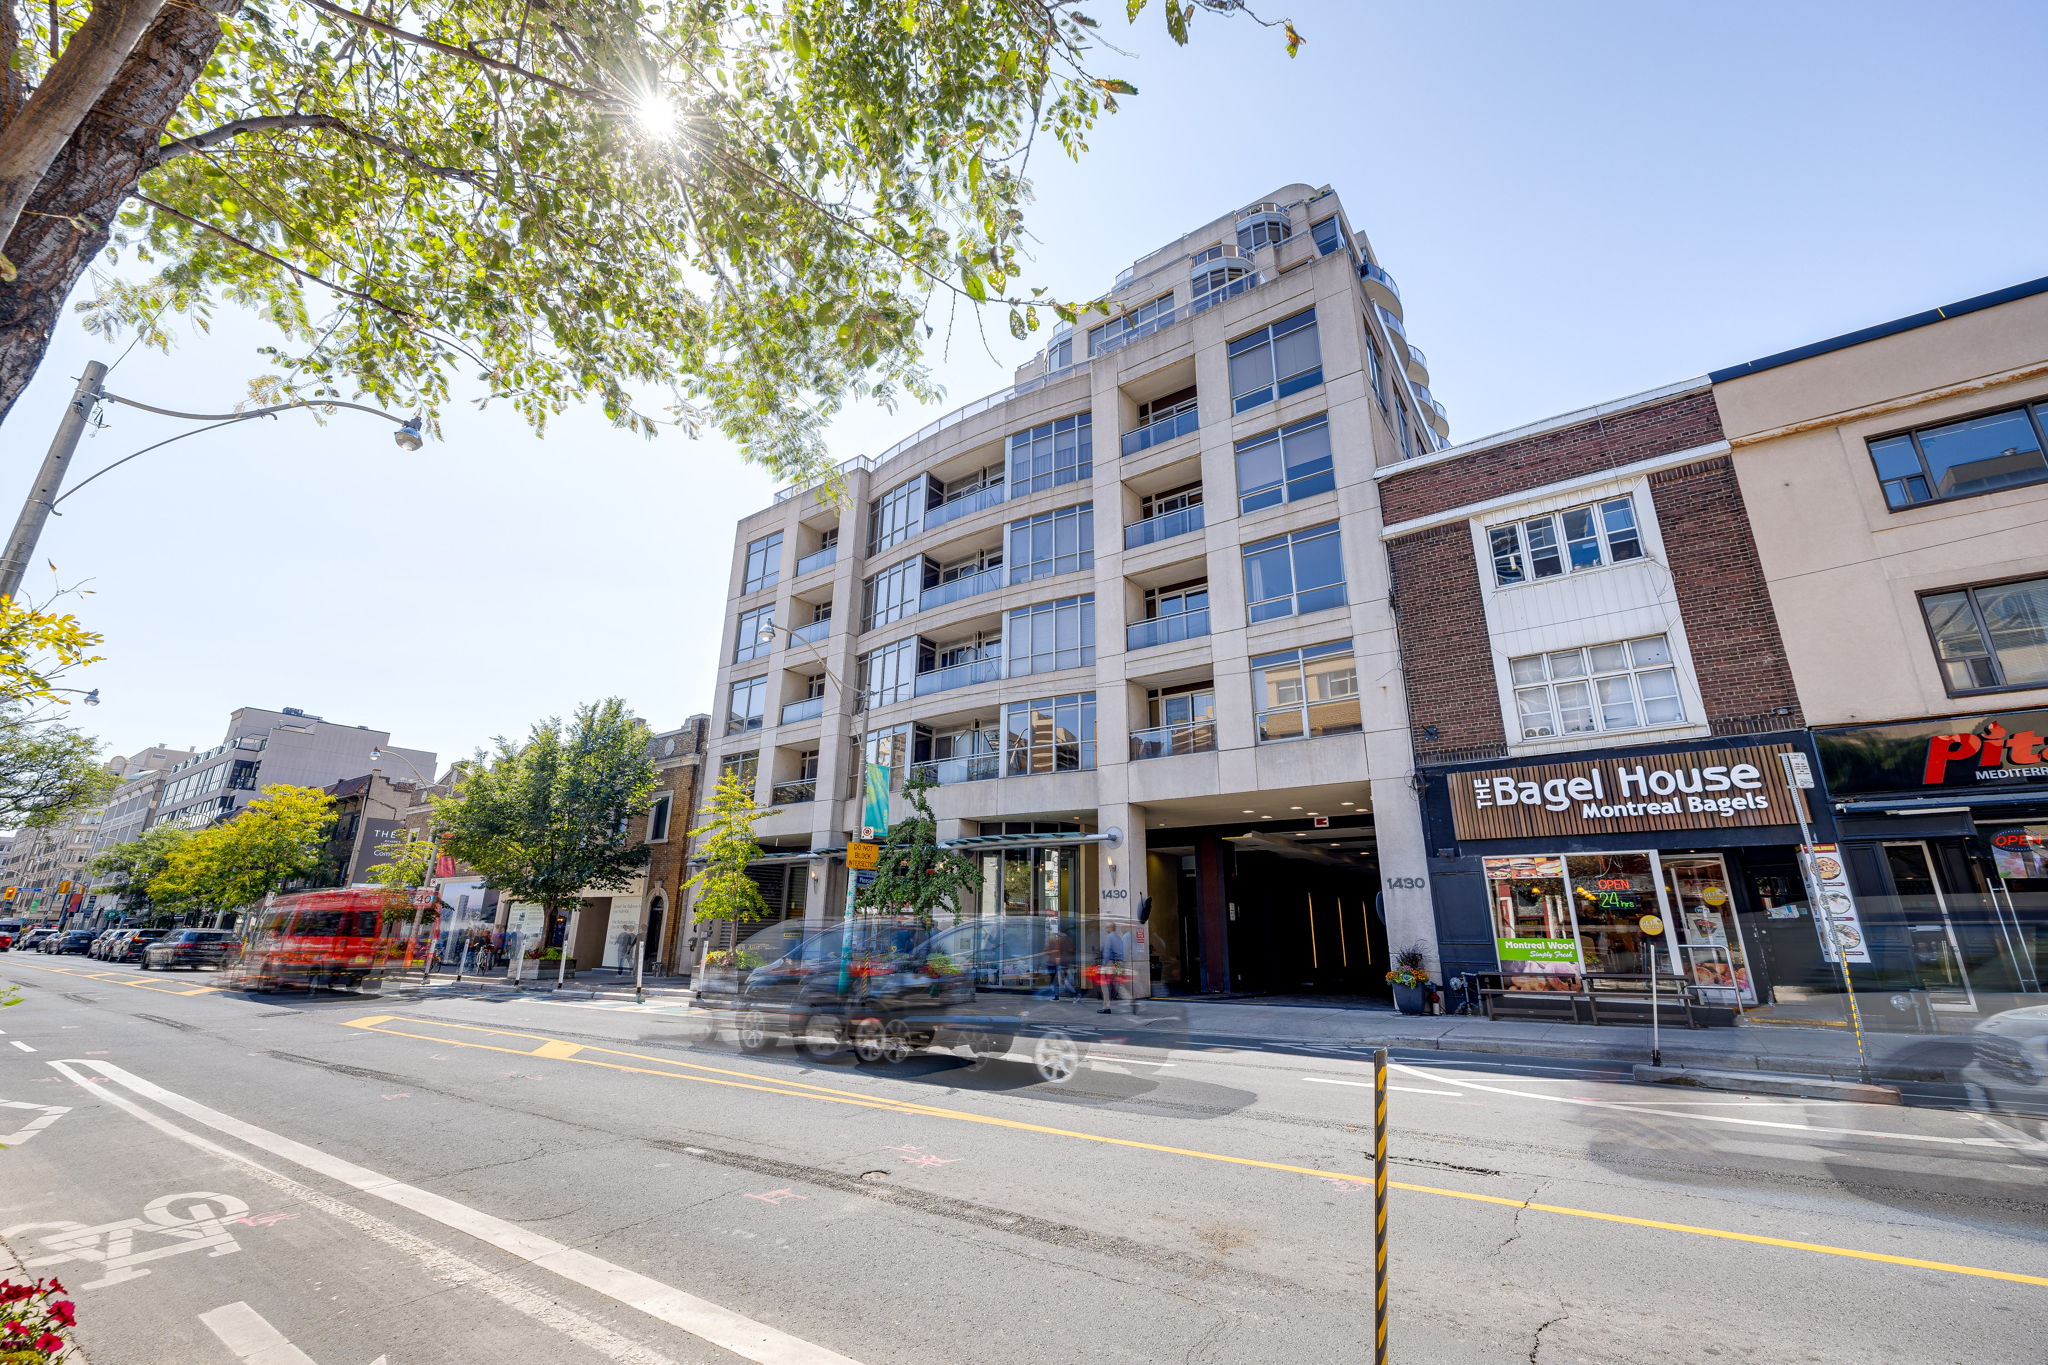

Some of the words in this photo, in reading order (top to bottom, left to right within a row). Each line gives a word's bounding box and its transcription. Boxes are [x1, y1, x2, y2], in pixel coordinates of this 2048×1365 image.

[1473, 778, 1491, 810] THE
[1492, 767, 1604, 812] Bagel
[1618, 763, 1763, 799] House
[1582, 797, 1684, 819] Montreal
[1689, 792, 1769, 817] Bagels
[1994, 834, 2043, 847] OPEN
[1386, 877, 1426, 890] 1430
[1598, 879, 1631, 890] OPEN
[1102, 889, 1128, 899] 1430
[1600, 891, 1620, 908] 24
[1620, 899, 1635, 908] hrs
[1504, 940, 1545, 950] Montreal
[1548, 942, 1576, 951] Wood
[1529, 950, 1553, 959] Simply
